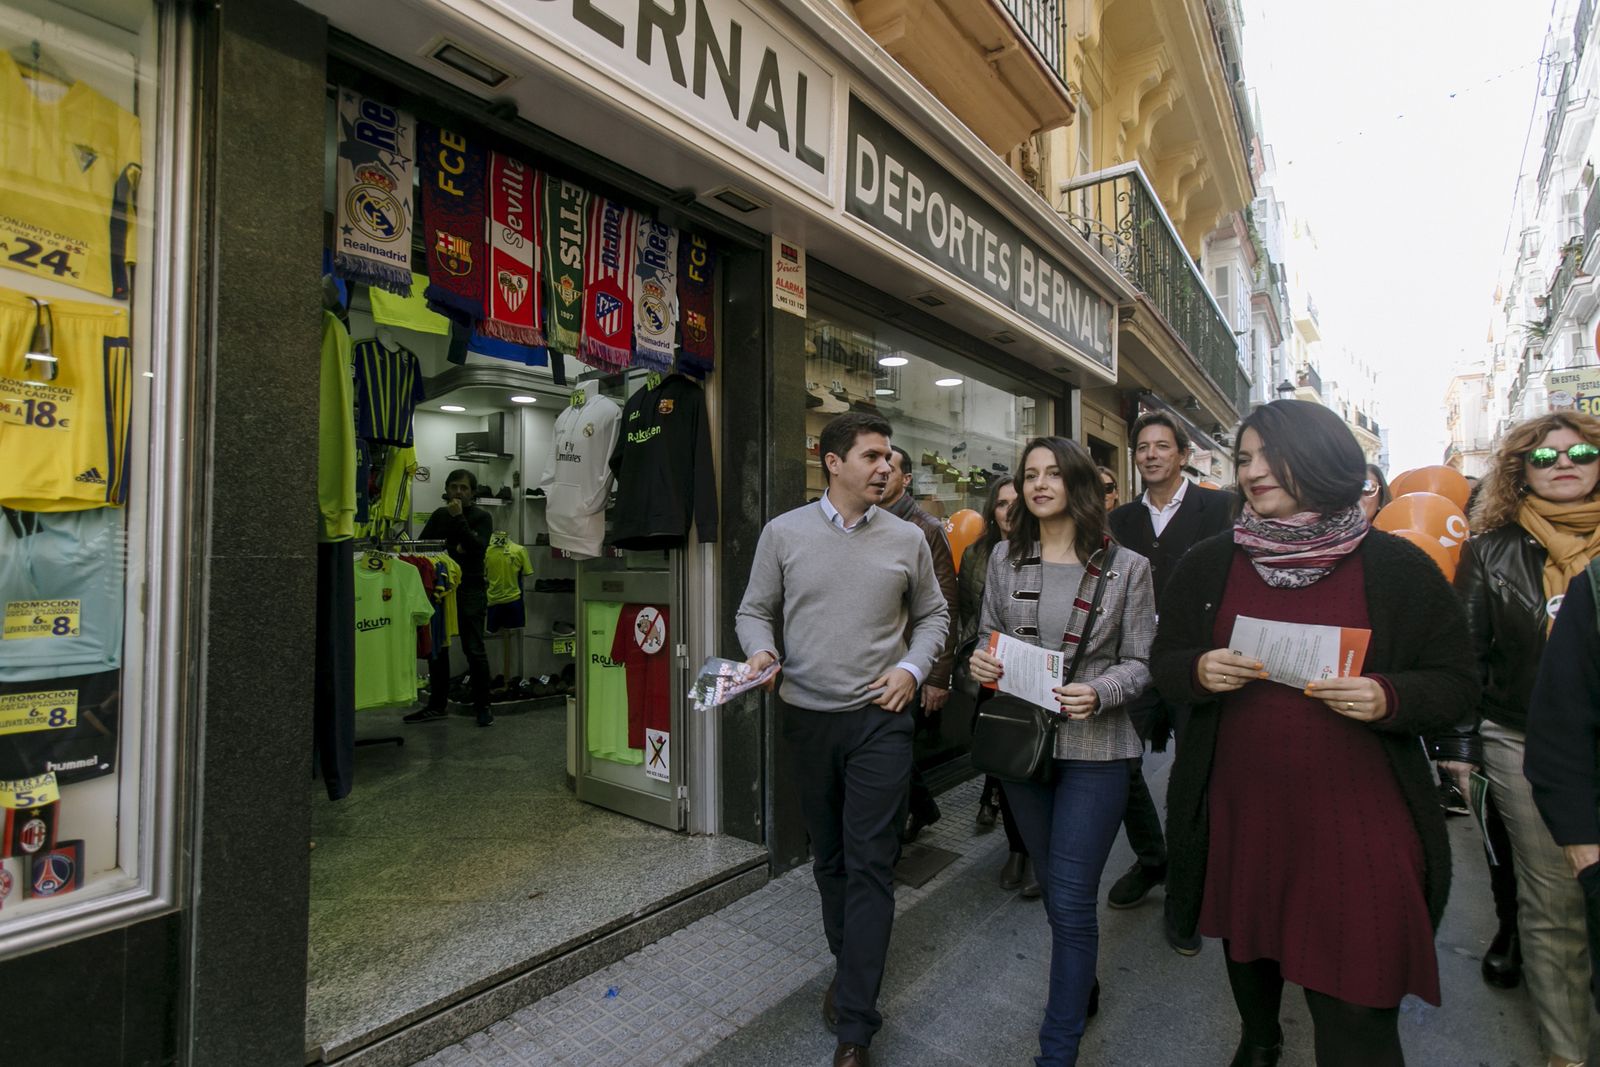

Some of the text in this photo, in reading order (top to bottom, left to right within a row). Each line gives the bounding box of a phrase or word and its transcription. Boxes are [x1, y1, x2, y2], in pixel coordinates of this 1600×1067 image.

[535, 0, 825, 175] RNAL
[343, 238, 407, 264] Realmadrid
[855, 134, 1104, 354] DEPORTES BERNAL
[776, 277, 804, 297] ALARMA
[47, 755, 98, 771] hummel
